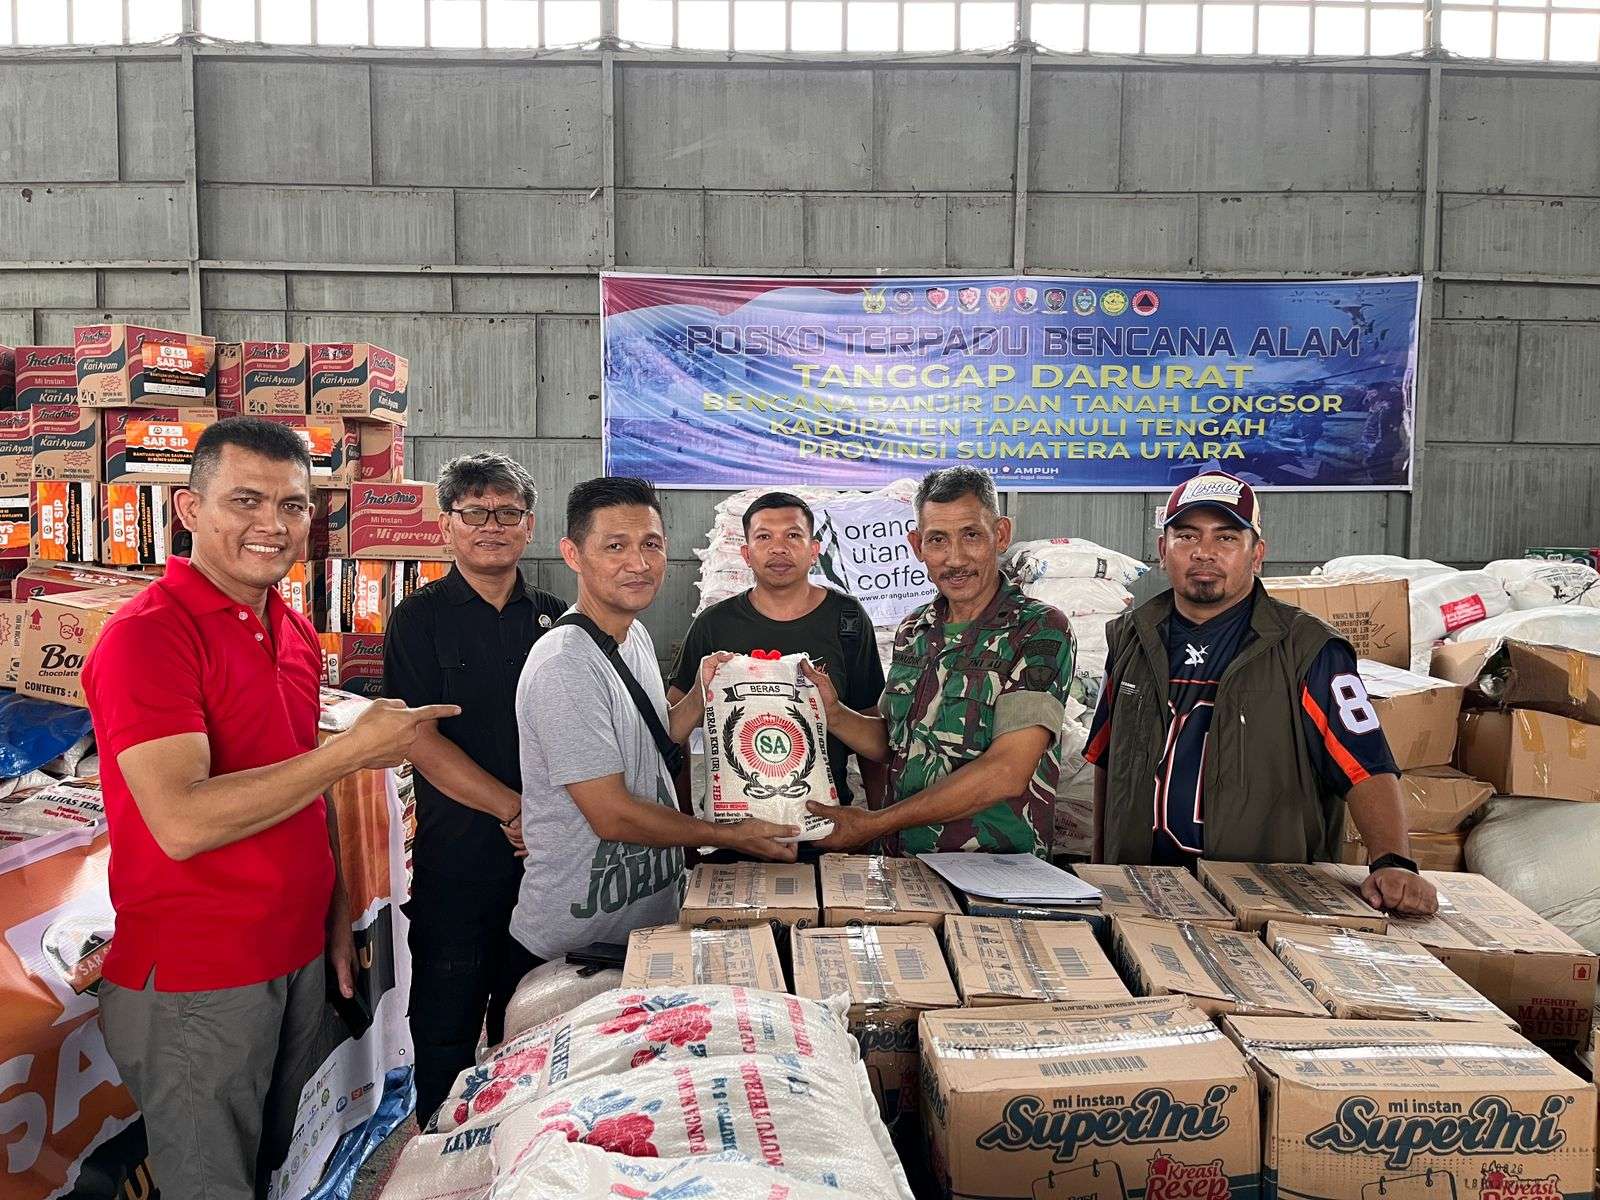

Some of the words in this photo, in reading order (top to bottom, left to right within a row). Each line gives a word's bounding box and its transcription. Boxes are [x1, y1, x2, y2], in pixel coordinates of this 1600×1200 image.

[686, 324, 826, 357] POSKO
[836, 325, 1029, 357] TERPADU
[1044, 326, 1235, 358] BENCANA
[1248, 326, 1361, 358] ALAM
[156, 357, 177, 367] SAR
[177, 359, 193, 369] SIP
[254, 375, 272, 383] Kari
[273, 376, 296, 386] Ayam
[320, 376, 337, 384] Kari
[338, 377, 360, 387] Ayam
[793, 363, 1016, 389] TANGGAP
[1031, 364, 1253, 389] DARURAT
[39, 393, 62, 402] Kari
[64, 393, 78, 405] Ay
[703, 391, 860, 414] BENCANA
[864, 394, 984, 414] BANJIR
[992, 394, 1061, 414] DAN
[1071, 394, 1179, 413] TANAH
[1191, 393, 1344, 414] LONGSOR
[37, 409, 76, 420] Indomie
[771, 416, 961, 437] KABUPATEN
[974, 419, 1127, 437] TAPANULI
[1136, 418, 1266, 437] TENGAH
[40, 437, 61, 447] Kari
[61, 440, 86, 449] Ayam
[143, 436, 166, 446] SAR
[170, 437, 189, 447] SIP
[800, 442, 948, 460] PROVINSI
[956, 442, 1130, 460] SUMATERA
[1141, 442, 1246, 460] UTARA
[1013, 467, 1059, 475] AMPUH
[361, 490, 418, 506] Indomie
[53, 499, 63, 519] SIP
[124, 502, 135, 521] SIP
[370, 516, 379, 524] Mi
[380, 516, 403, 525] Instan
[0, 525, 14, 534] SA
[54, 524, 64, 545] SAR
[126, 525, 136, 548] SAR
[393, 529, 442, 545] goreng
[853, 544, 909, 564] utan
[858, 565, 933, 591] coffe
[24, 681, 66, 696] CONTENTS
[72, 690, 78, 698] 4
[362, 683, 383, 694] Kar
[750, 685, 781, 693] BERAS
[1331, 673, 1381, 734] 8
[706, 706, 716, 734] BERAS
[711, 734, 719, 757] KKB
[759, 735, 788, 754] SA
[711, 758, 720, 772] (IR)
[713, 785, 722, 801] HB
[78, 956, 104, 977] SAR
[1518, 1005, 1589, 1022] MARIE
[1523, 1020, 1580, 1036] SUSU
[0, 1016, 123, 1173] SA
[1053, 1095, 1073, 1108] mi
[1076, 1095, 1125, 1107] instan
[1388, 1100, 1408, 1113] mi
[1412, 1101, 1462, 1114] instan
[976, 1085, 1230, 1163] SuperMi
[1306, 1095, 1567, 1170] SuperMi
[756, 1122, 784, 1167] MUTU
[1167, 1163, 1220, 1179] Kreasi
[1149, 1176, 1231, 1200] Resep
[1502, 1180, 1554, 1196] Kreasi
